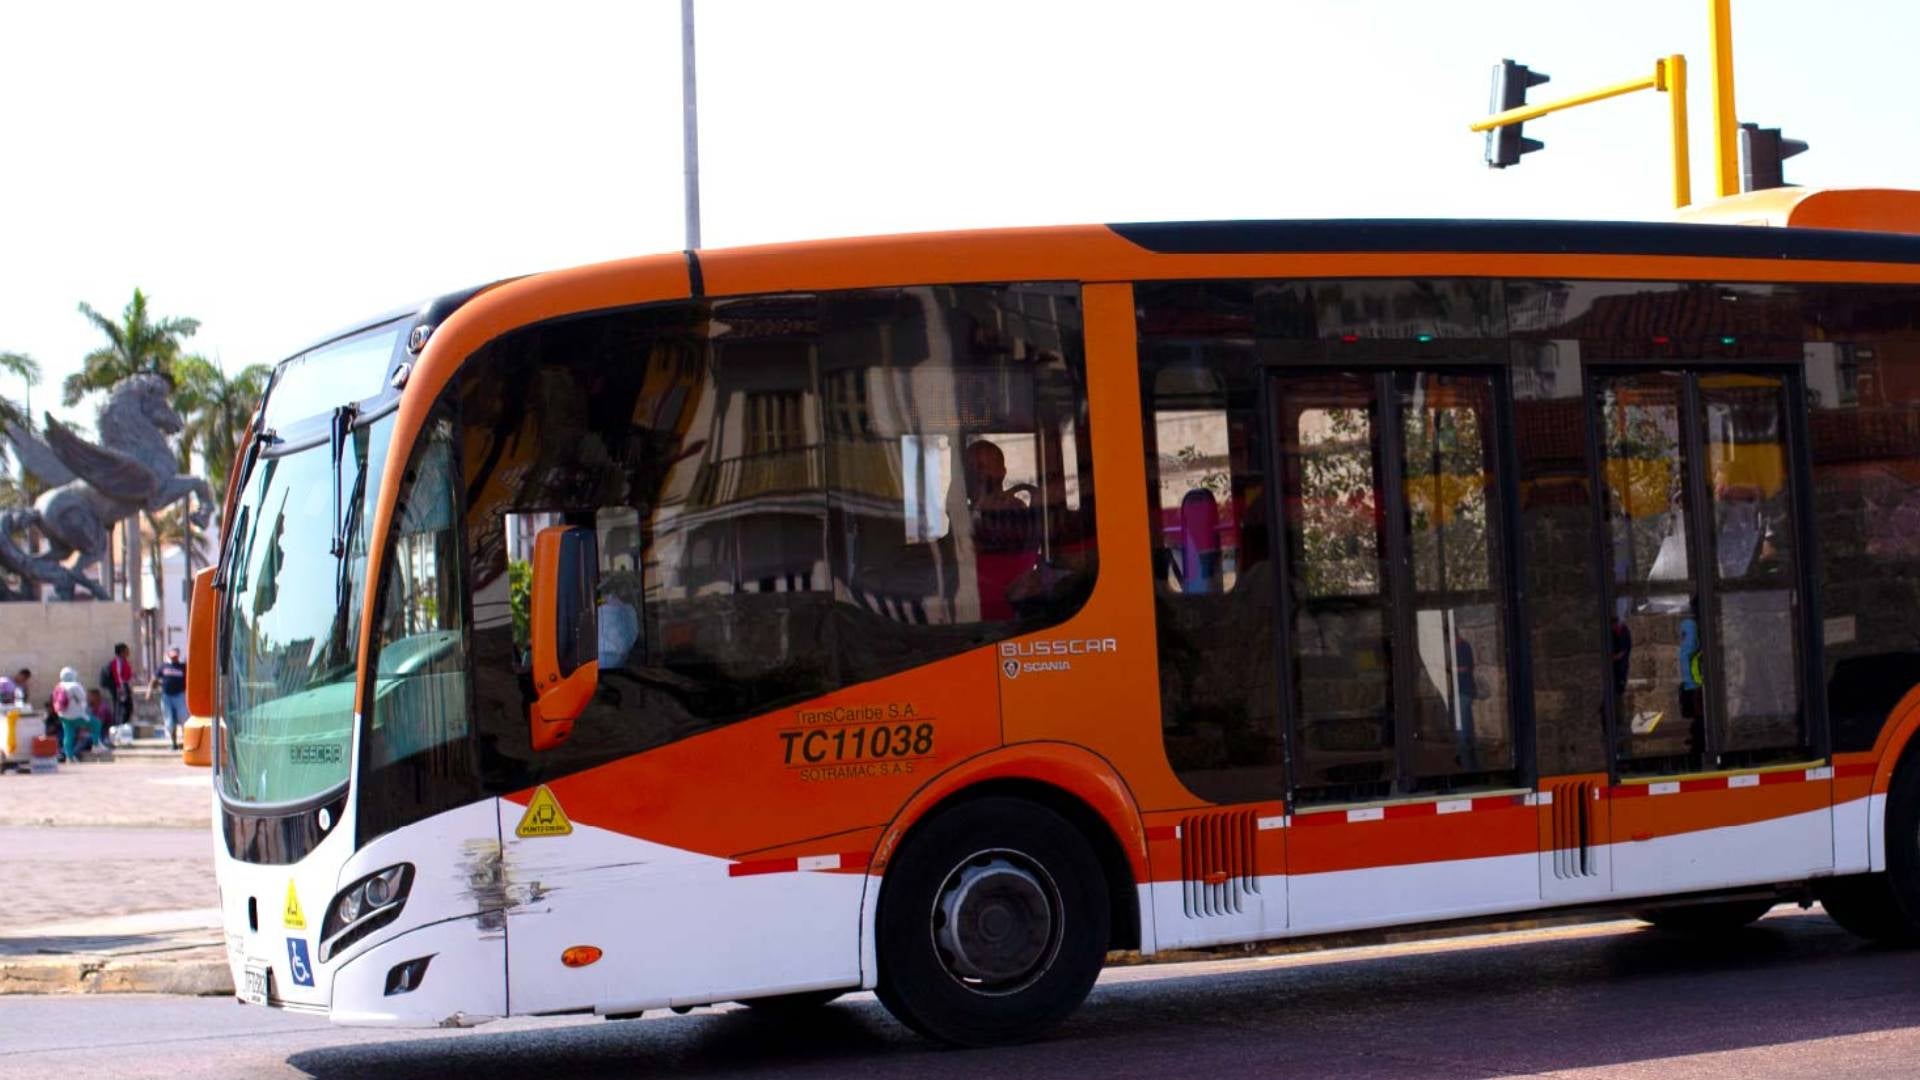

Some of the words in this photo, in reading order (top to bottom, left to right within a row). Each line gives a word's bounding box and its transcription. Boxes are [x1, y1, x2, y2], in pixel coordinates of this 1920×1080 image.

[1000, 638, 1117, 657] BUSSCAR
[1023, 661, 1071, 672] SCANIA
[796, 705, 883, 725] TransCaribe
[779, 723, 934, 764] TC11038
[801, 764, 876, 782] SOTRAMAC
